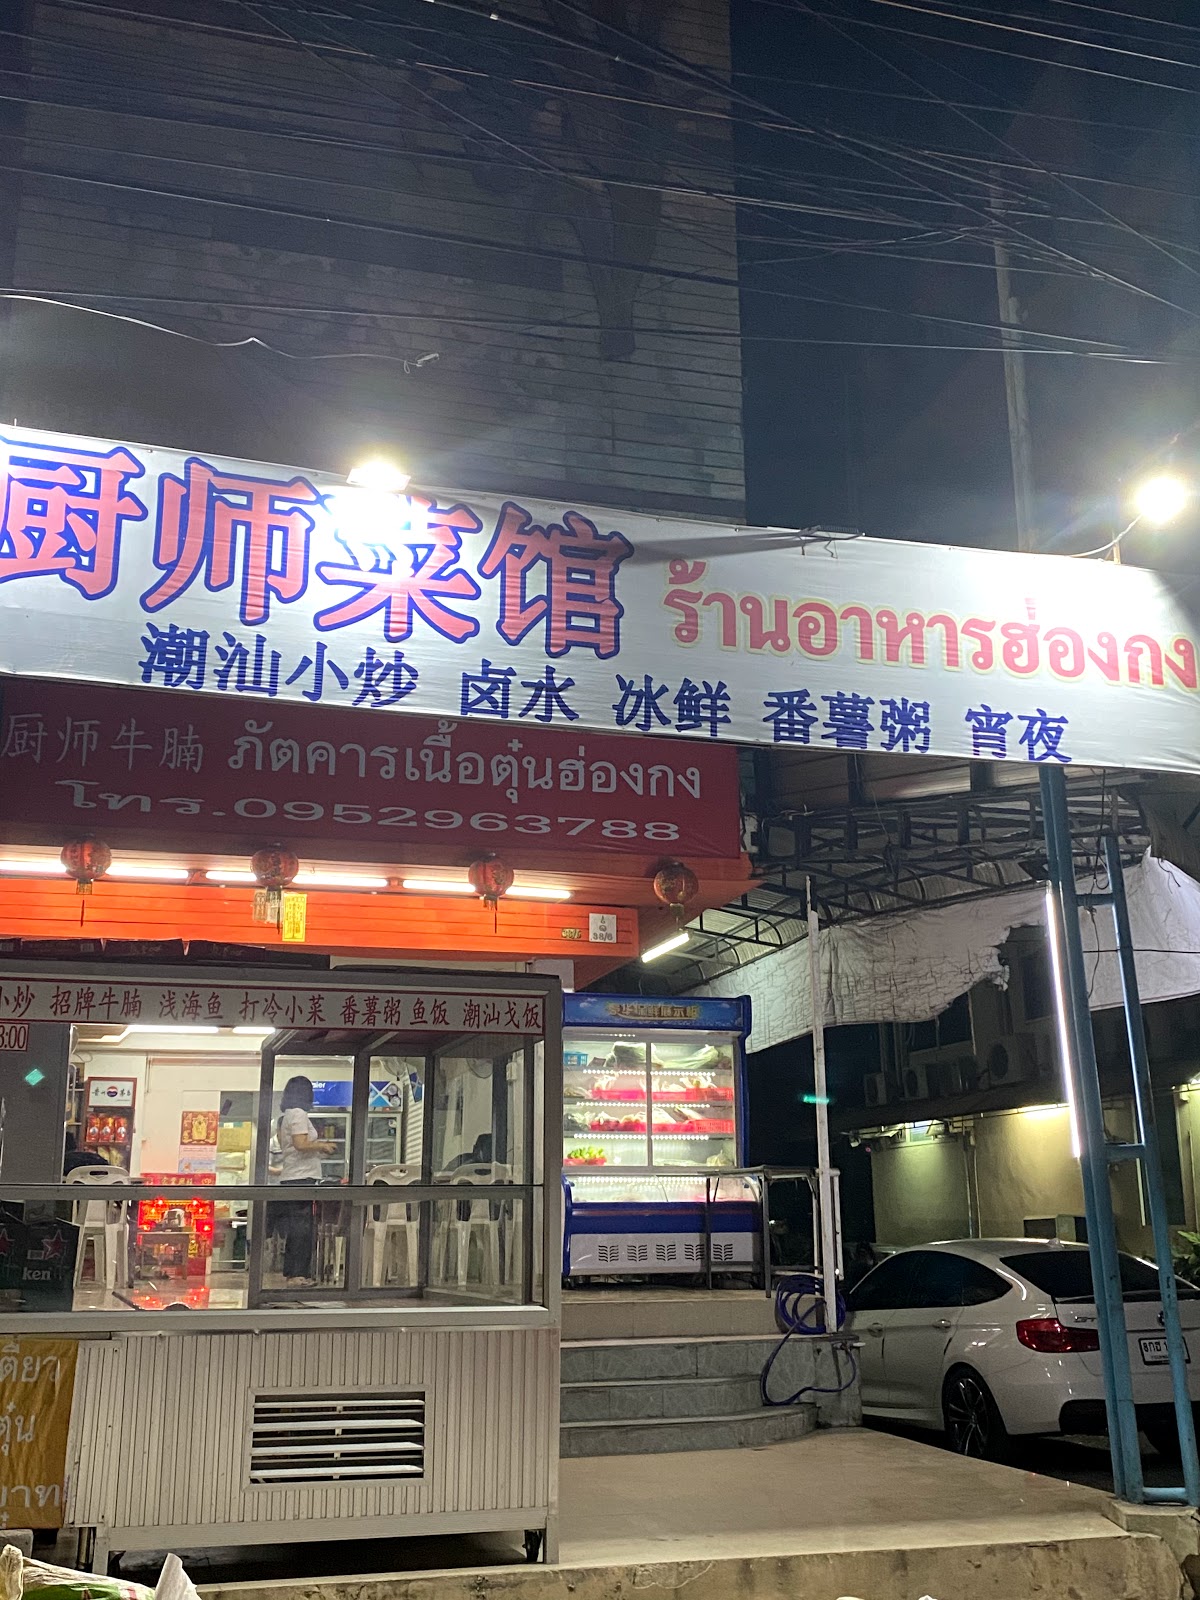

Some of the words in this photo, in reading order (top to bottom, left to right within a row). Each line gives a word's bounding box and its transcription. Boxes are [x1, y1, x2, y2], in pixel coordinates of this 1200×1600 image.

[0, 436, 634, 659] 厨师菜馆
[664, 558, 1199, 692] ร้านอาหารฮ่องกง
[4, 712, 204, 774] 厨师牛腩
[138, 622, 419, 708] 潮汕小炒
[460, 660, 580, 723] 卤水
[613, 674, 732, 738] 冰鲜
[763, 689, 931, 755] 番薯粥
[965, 704, 1072, 764] 宵夜
[228, 719, 701, 804] ภัตคารเนื้อตุ๋นฮ่องกง
[50, 986, 142, 1021] 招牌牛腩
[158, 989, 223, 1022] 浅海鱼
[239, 992, 326, 1027] 打冷小菜
